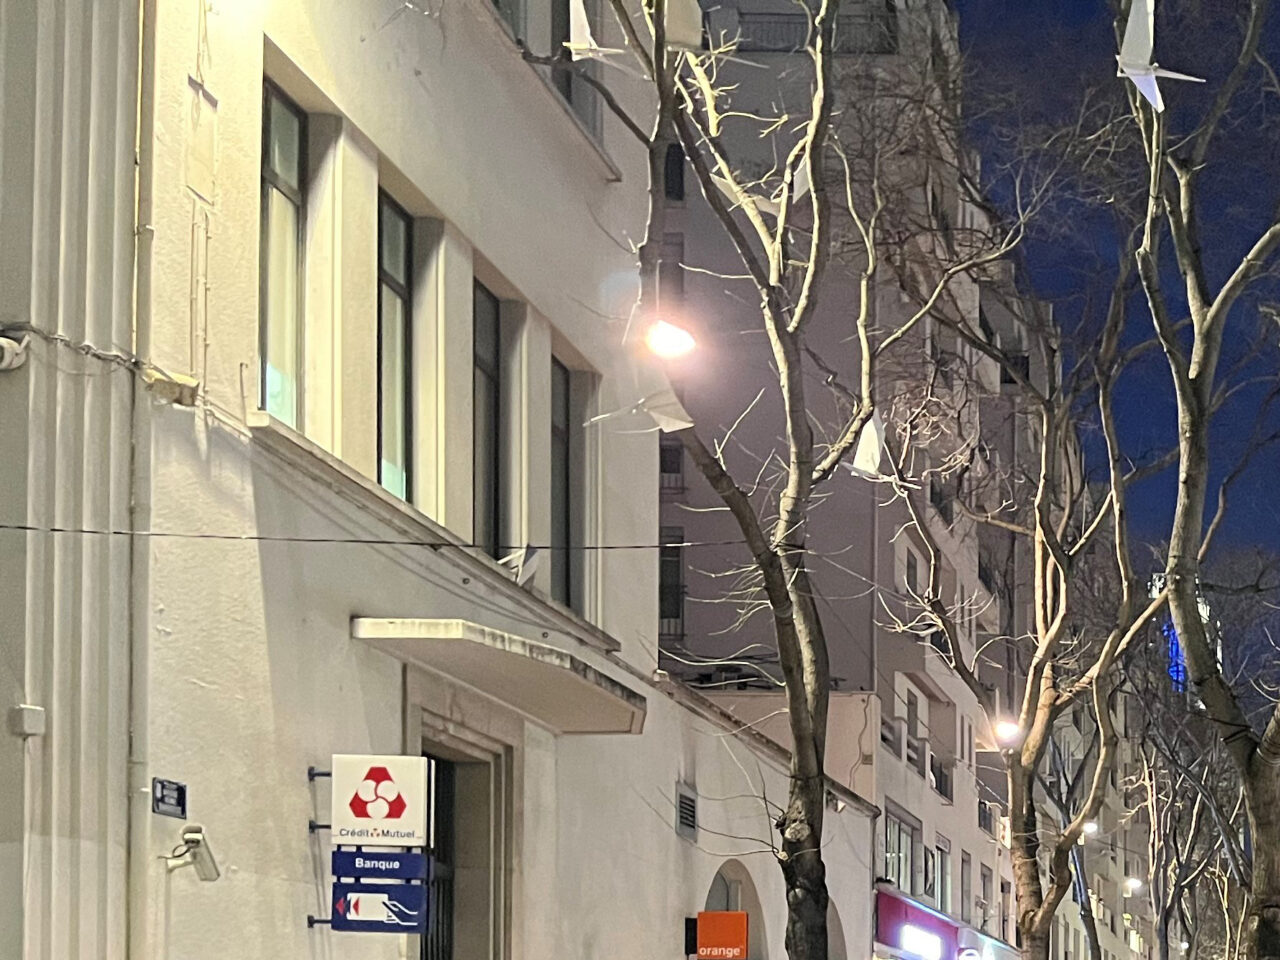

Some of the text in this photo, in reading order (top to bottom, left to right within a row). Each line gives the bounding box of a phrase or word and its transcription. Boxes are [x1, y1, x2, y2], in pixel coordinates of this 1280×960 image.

[340, 828, 415, 838] Crédit Mutuel
[355, 857, 400, 871] Banque
[699, 947, 741, 958] orange
